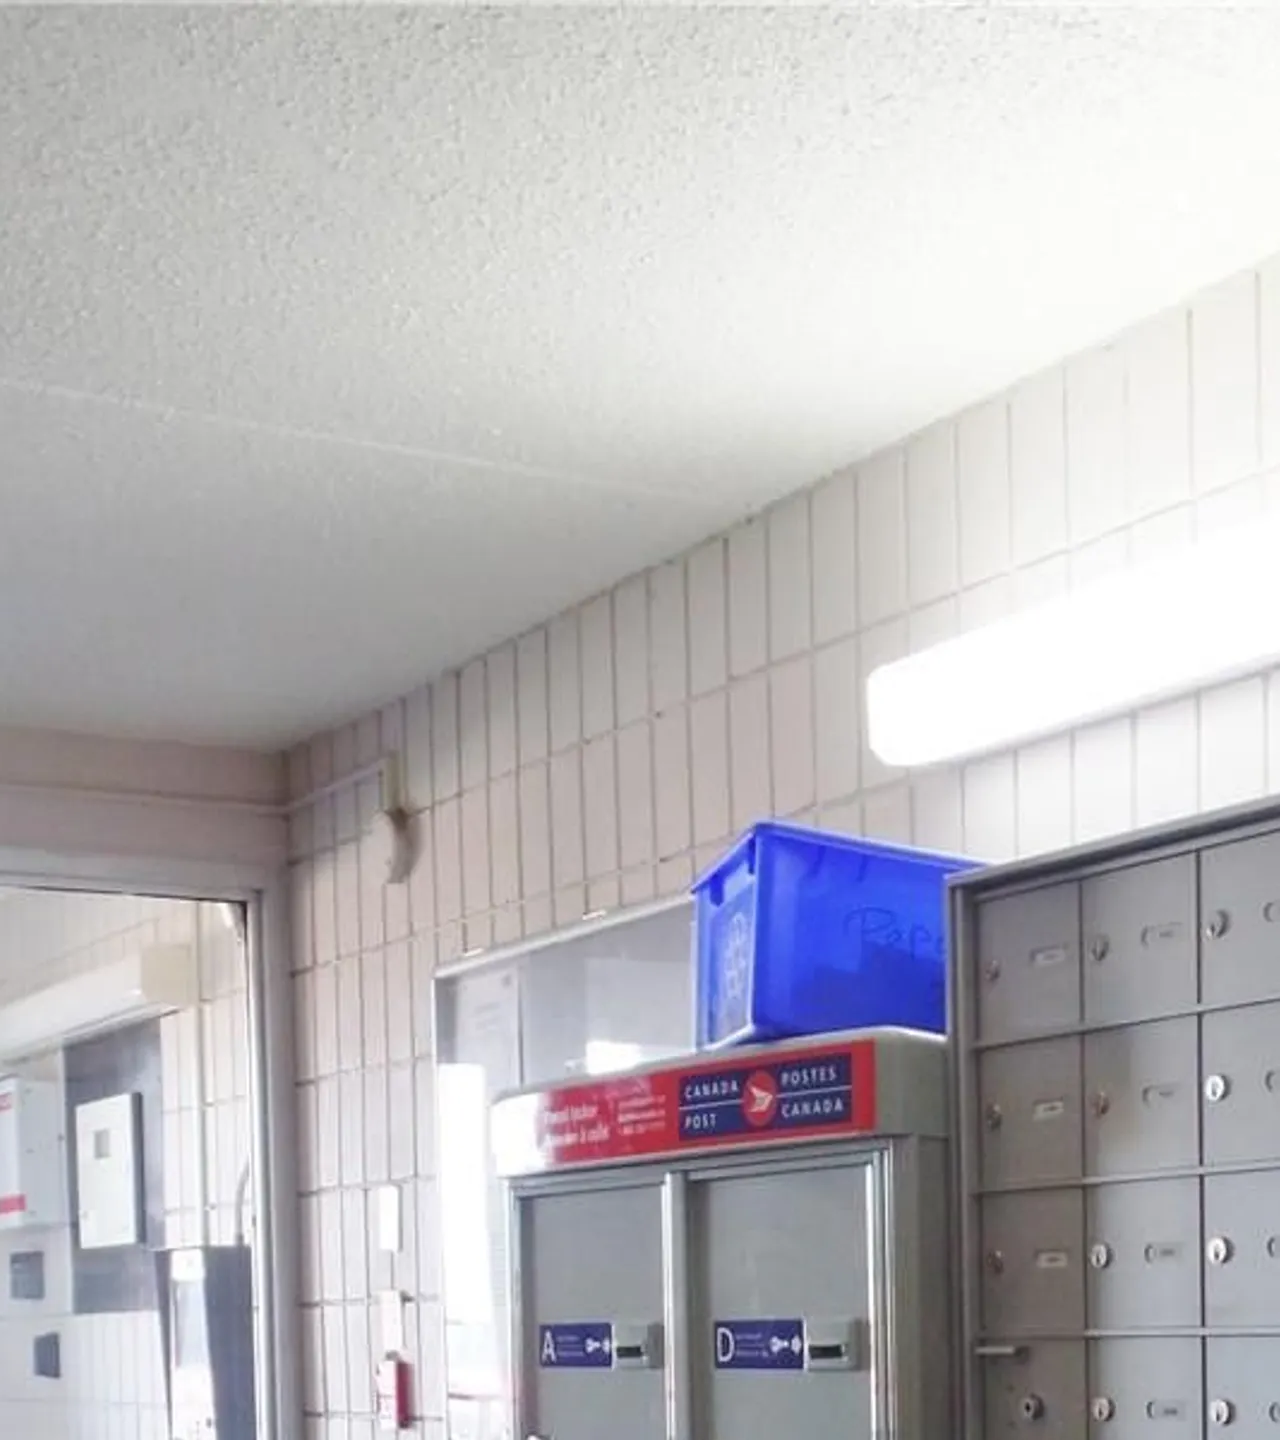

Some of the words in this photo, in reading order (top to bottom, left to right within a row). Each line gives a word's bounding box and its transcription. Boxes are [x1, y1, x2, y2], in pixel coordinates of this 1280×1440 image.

[780, 1064, 838, 1088] POSTES
[684, 1079, 741, 1100] CANADA
[780, 1096, 844, 1120] CANADA
[684, 1112, 718, 1131] POST
[541, 1329, 557, 1364] A
[717, 1326, 735, 1362] D
